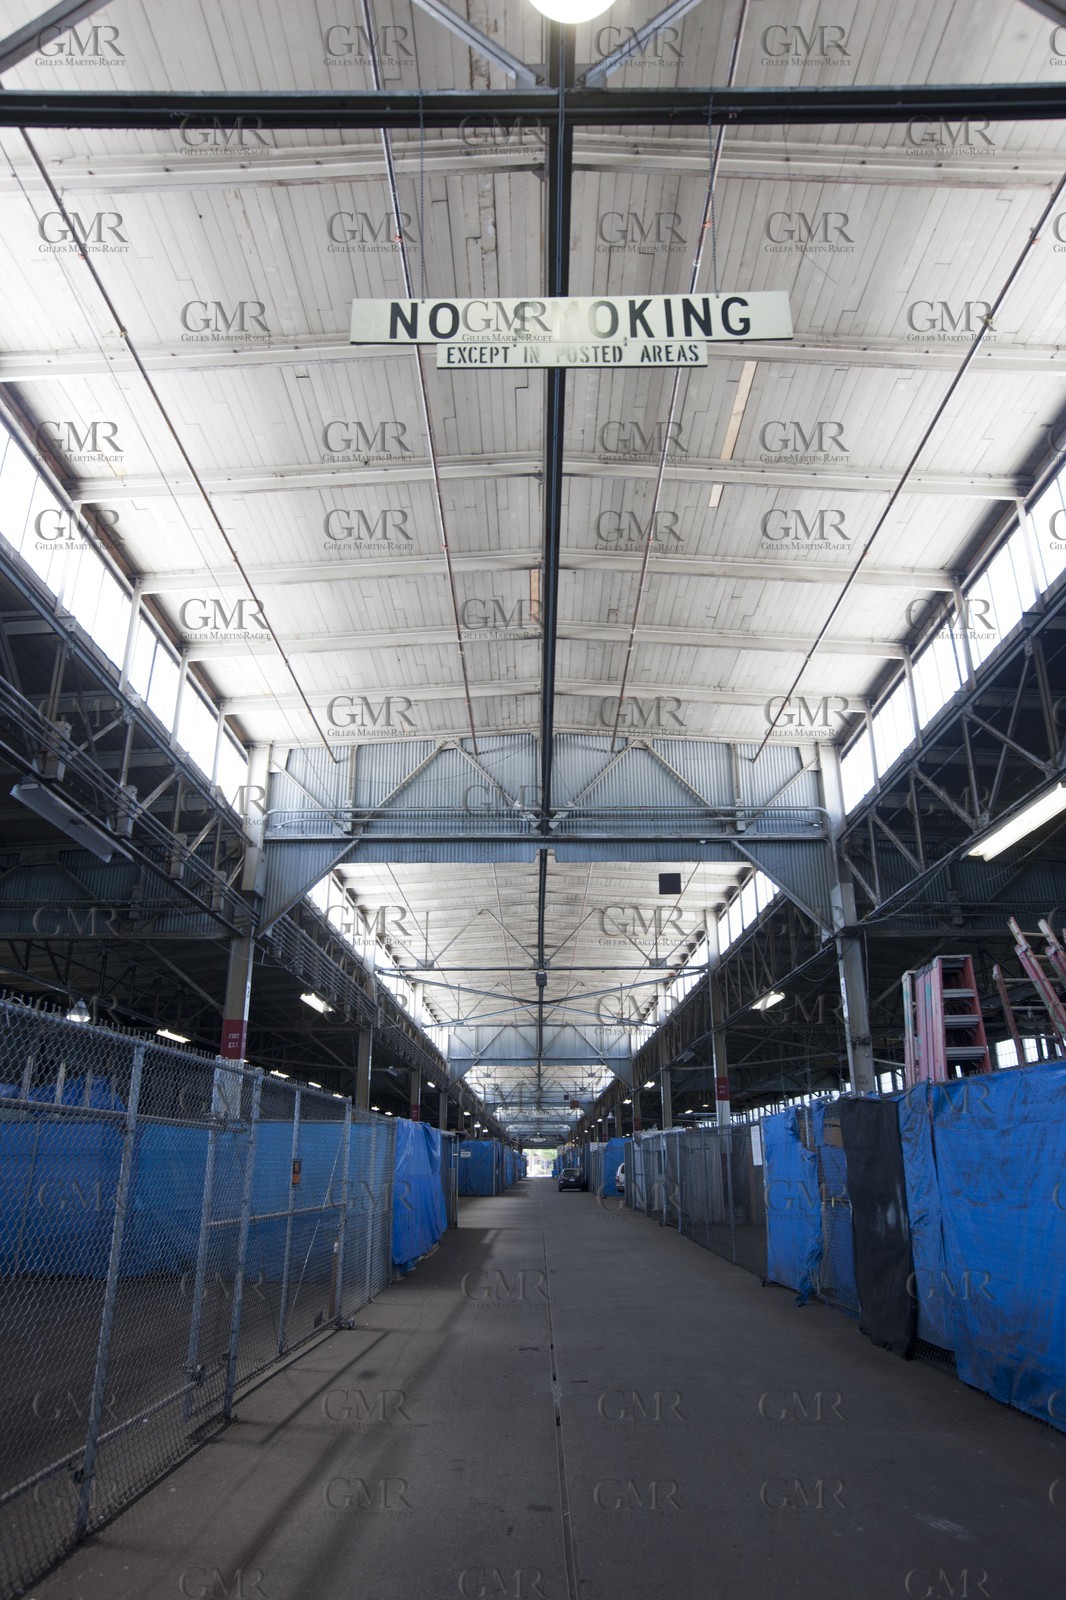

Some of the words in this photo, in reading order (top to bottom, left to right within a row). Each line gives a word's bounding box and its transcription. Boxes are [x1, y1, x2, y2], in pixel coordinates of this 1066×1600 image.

[389, 302, 460, 339] NO
[447, 346, 510, 364] EXCEPT
[523, 346, 540, 364] IN
[555, 345, 623, 364] POSTED
[640, 344, 700, 363] AREAS
